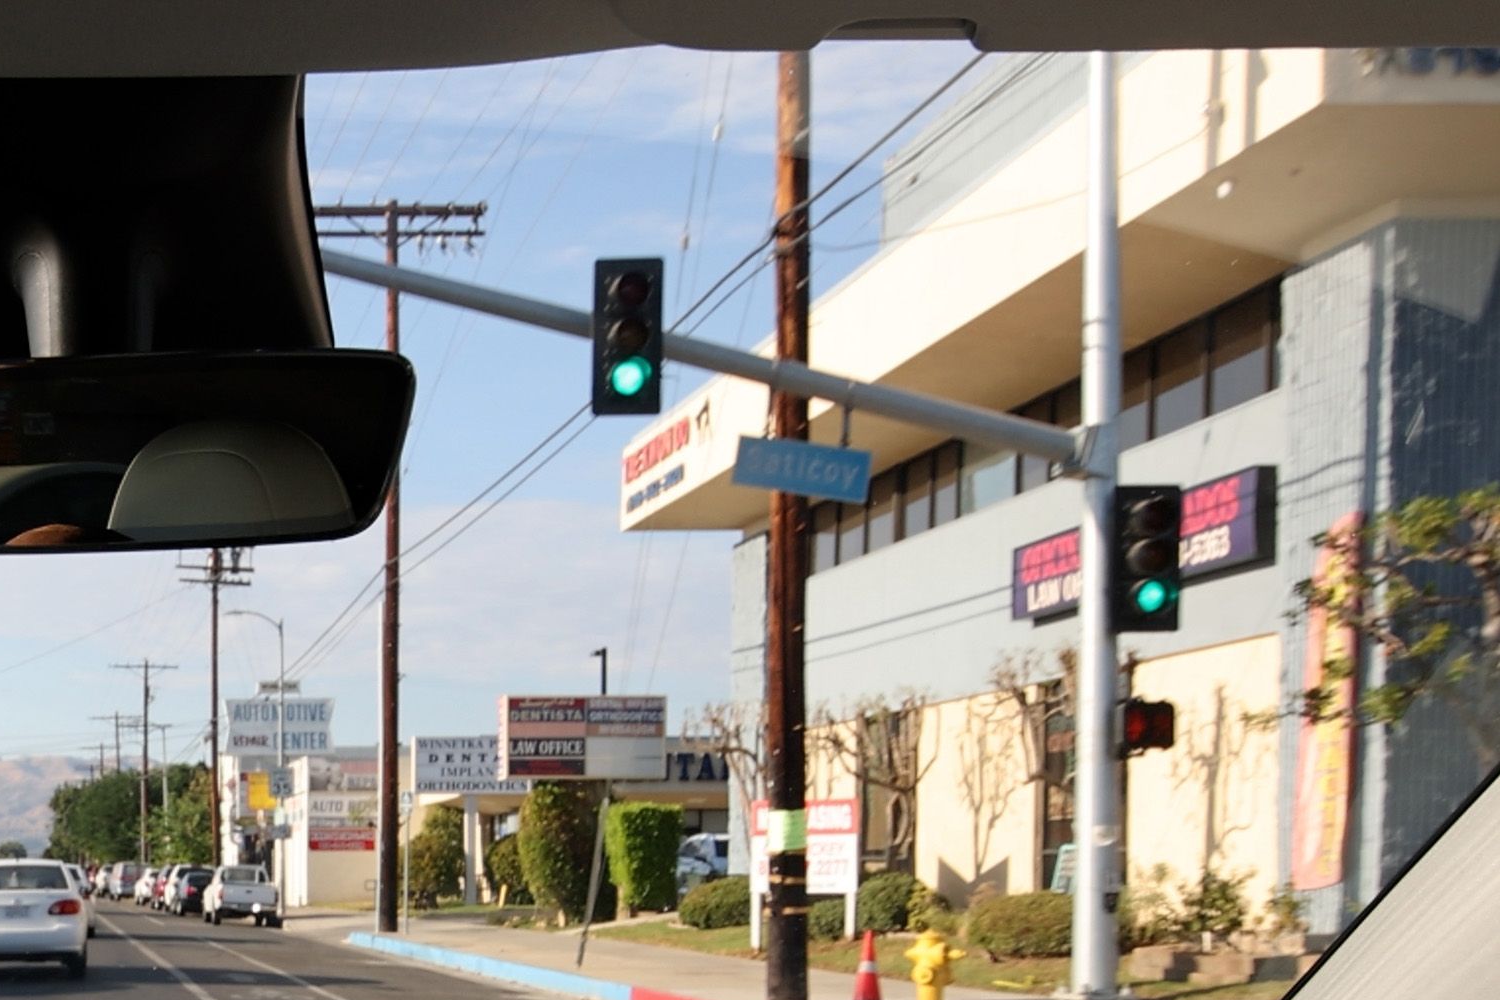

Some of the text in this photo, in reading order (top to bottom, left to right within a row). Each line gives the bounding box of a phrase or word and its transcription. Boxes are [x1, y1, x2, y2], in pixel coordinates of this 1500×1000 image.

[510, 709, 583, 721] DENTISTA
[417, 740, 484, 749] WINNETKA
[510, 741, 536, 755] LAW
[539, 740, 583, 755] OFFICE
[441, 767, 495, 777] IMPLAN
[417, 781, 527, 791] ORTHODONTICS
[310, 800, 343, 812] AUTO
